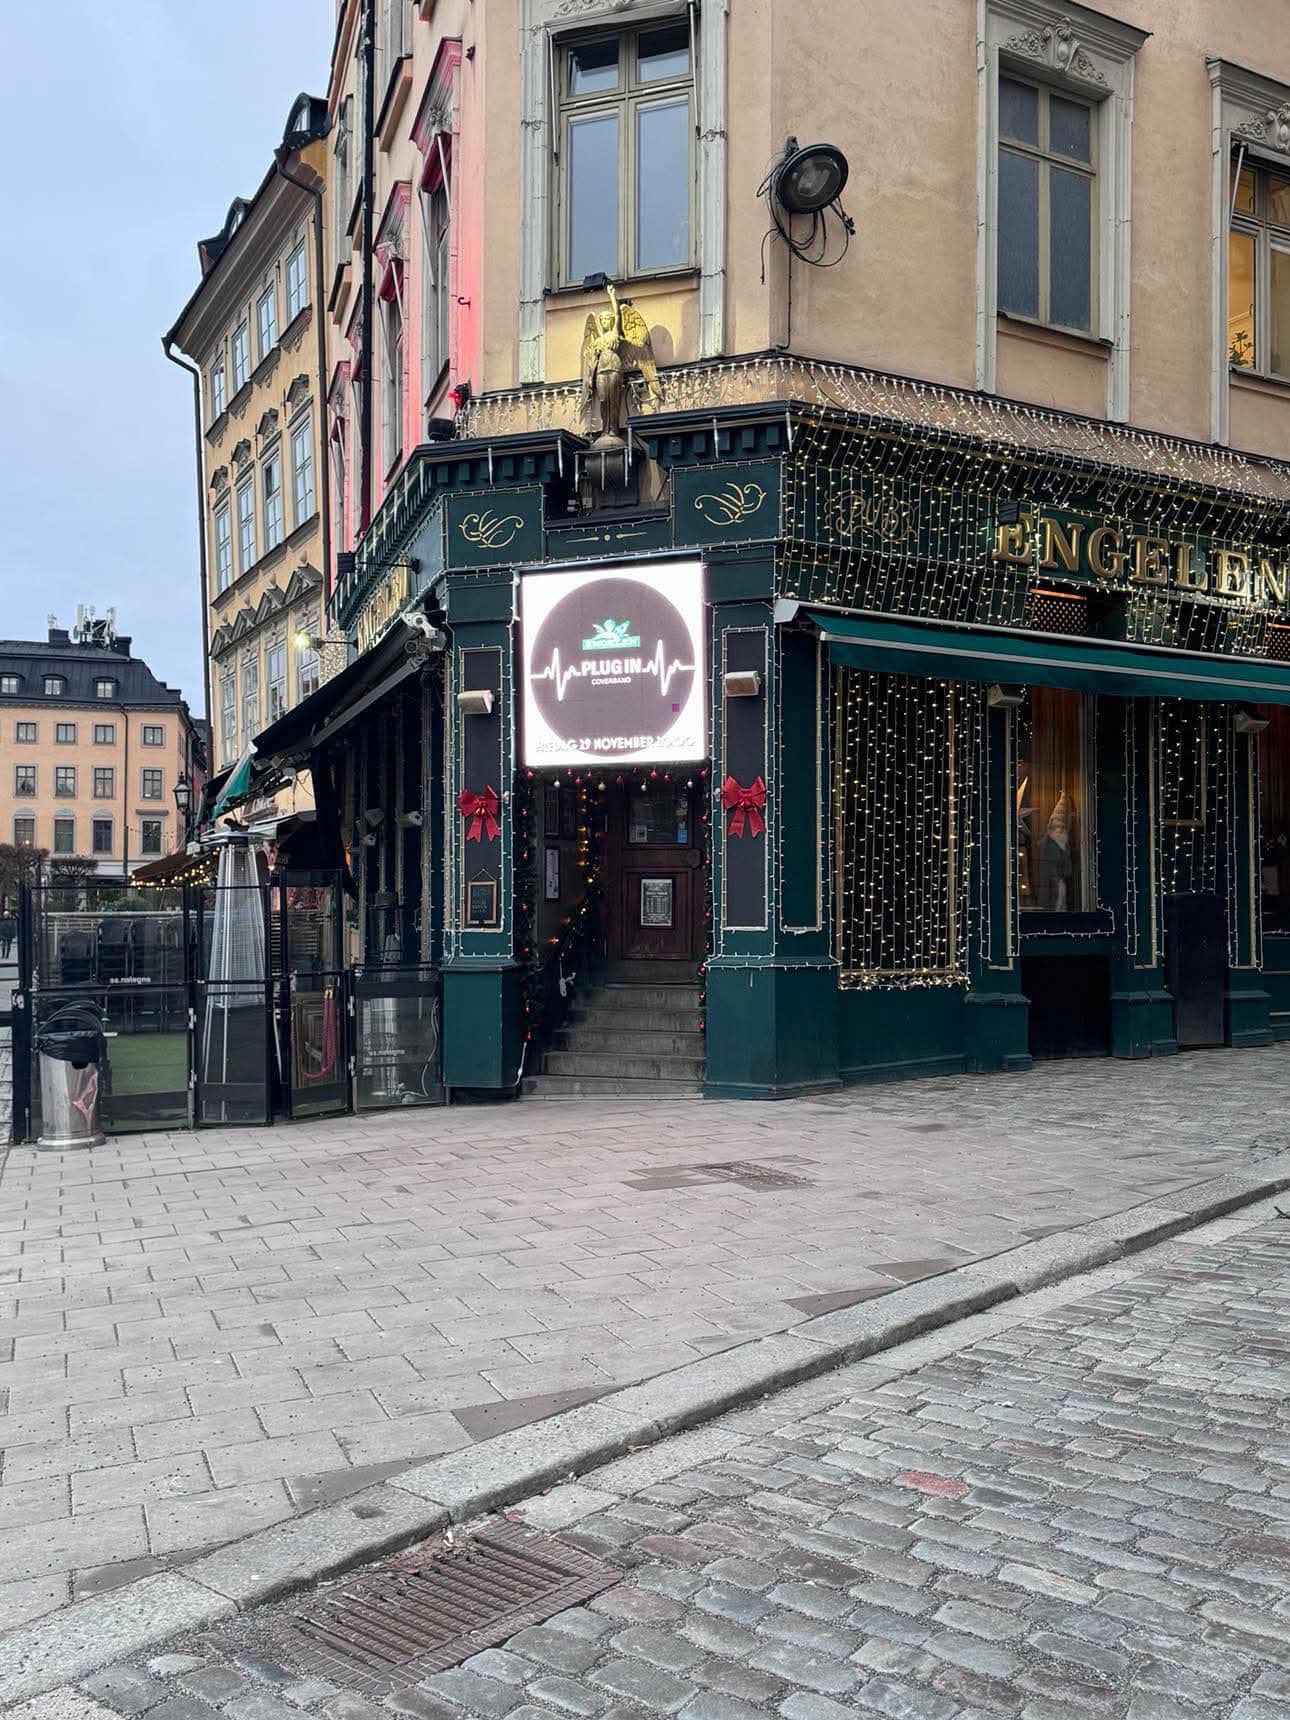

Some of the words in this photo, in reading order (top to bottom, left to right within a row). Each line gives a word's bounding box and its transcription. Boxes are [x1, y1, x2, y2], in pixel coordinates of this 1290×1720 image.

[991, 510, 1289, 603] ENGELEN
[581, 659, 623, 677] PLUG
[624, 658, 641, 674] IN
[593, 735, 655, 751] NOVEMBER
